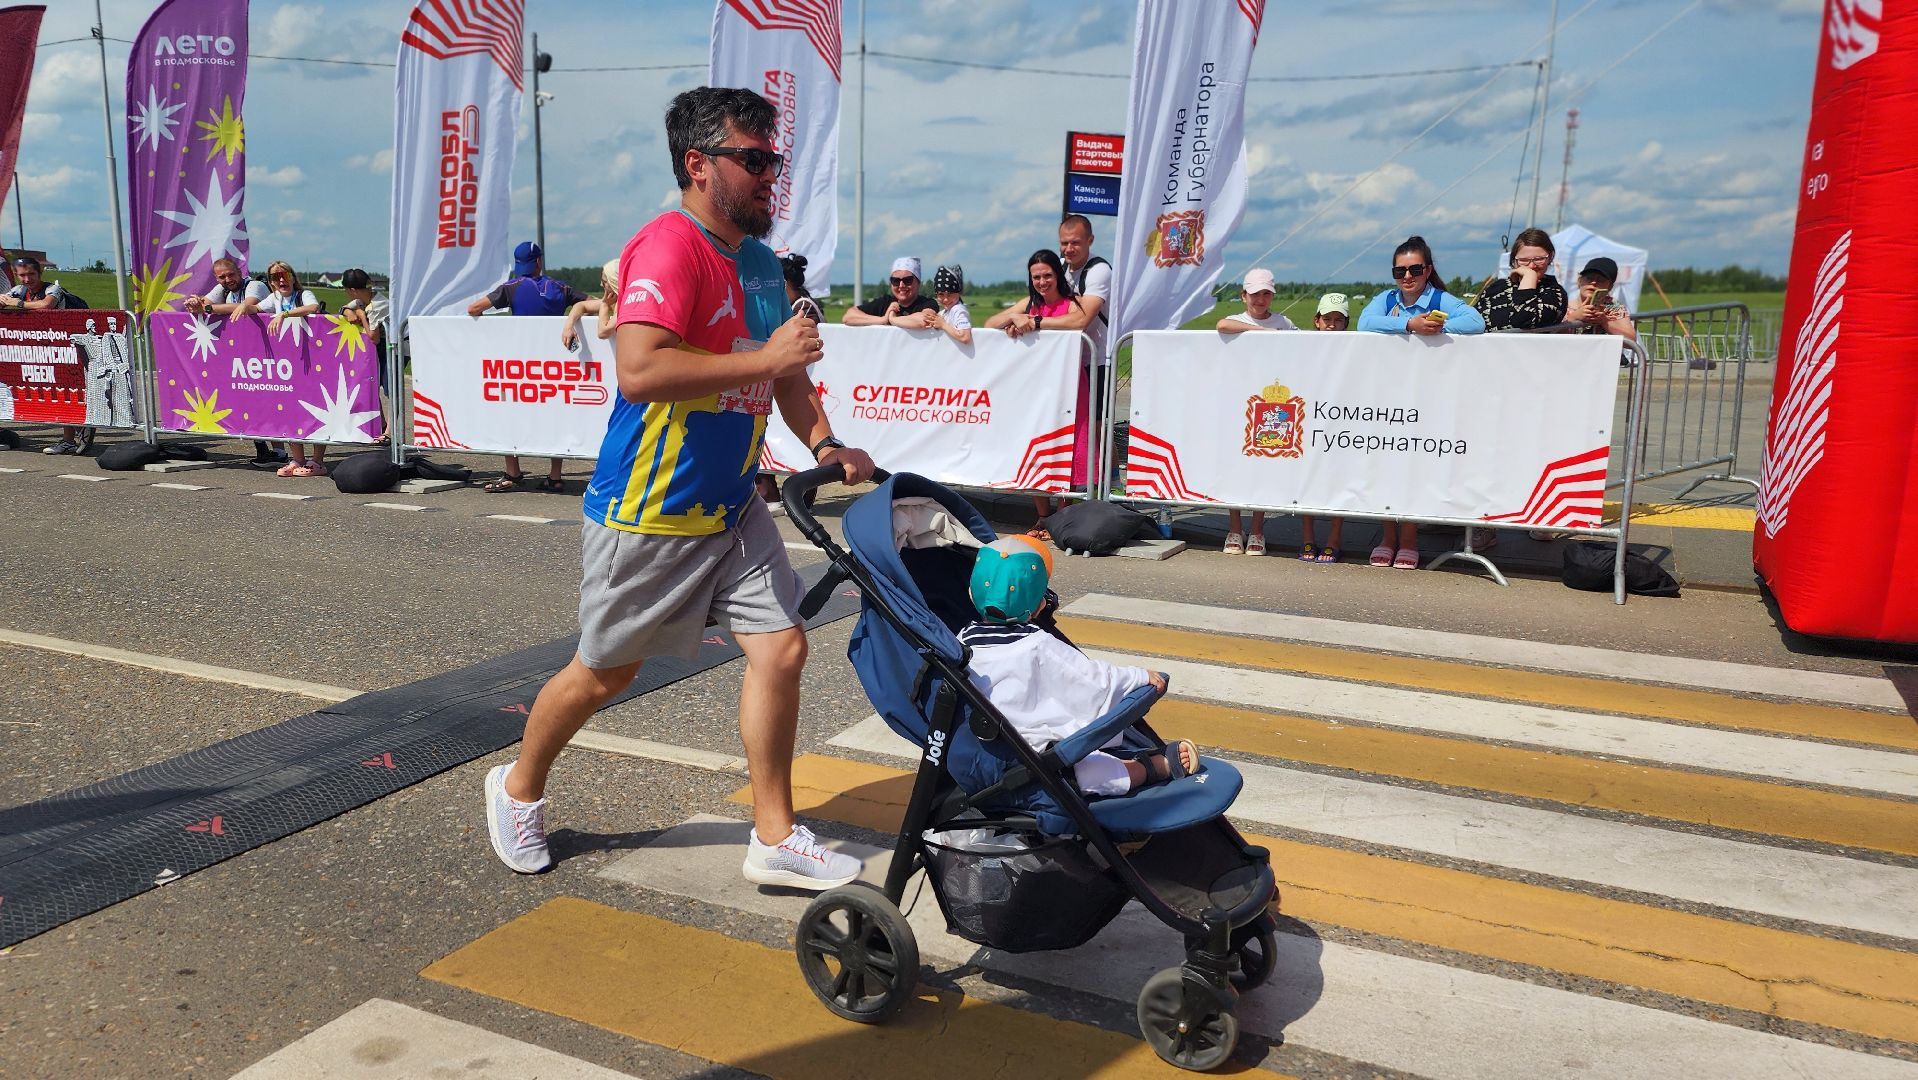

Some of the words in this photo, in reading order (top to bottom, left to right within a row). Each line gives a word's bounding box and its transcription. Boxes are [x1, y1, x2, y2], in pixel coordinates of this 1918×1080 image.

[1187, 62, 1216, 202] Губернатора
[778, 71, 797, 221] ПОДМОСКОВЬЯ
[1076, 139, 1113, 150] Выдача
[1075, 158, 1114, 167] пакетов
[1161, 108, 1187, 206] Команда
[438, 111, 460, 249] МОСОБЛ
[1074, 184, 1106, 195] Камера
[458, 140, 479, 248] СПОРТ
[1073, 195, 1114, 205] хранения
[624, 290, 648, 305] ANTA
[0, 327, 68, 343] Полумарафон
[21, 364, 57, 384] РУБЕЖ
[482, 359, 602, 382] МОСОБЛ
[483, 381, 576, 405] СПОРТ
[852, 384, 992, 408] СУПЕРЛИГА
[852, 405, 991, 425] ПОДМОСКОВЬЯ
[1313, 400, 1420, 426] Команда
[1311, 429, 1468, 458] Губернатора
[925, 729, 946, 767] Joie
